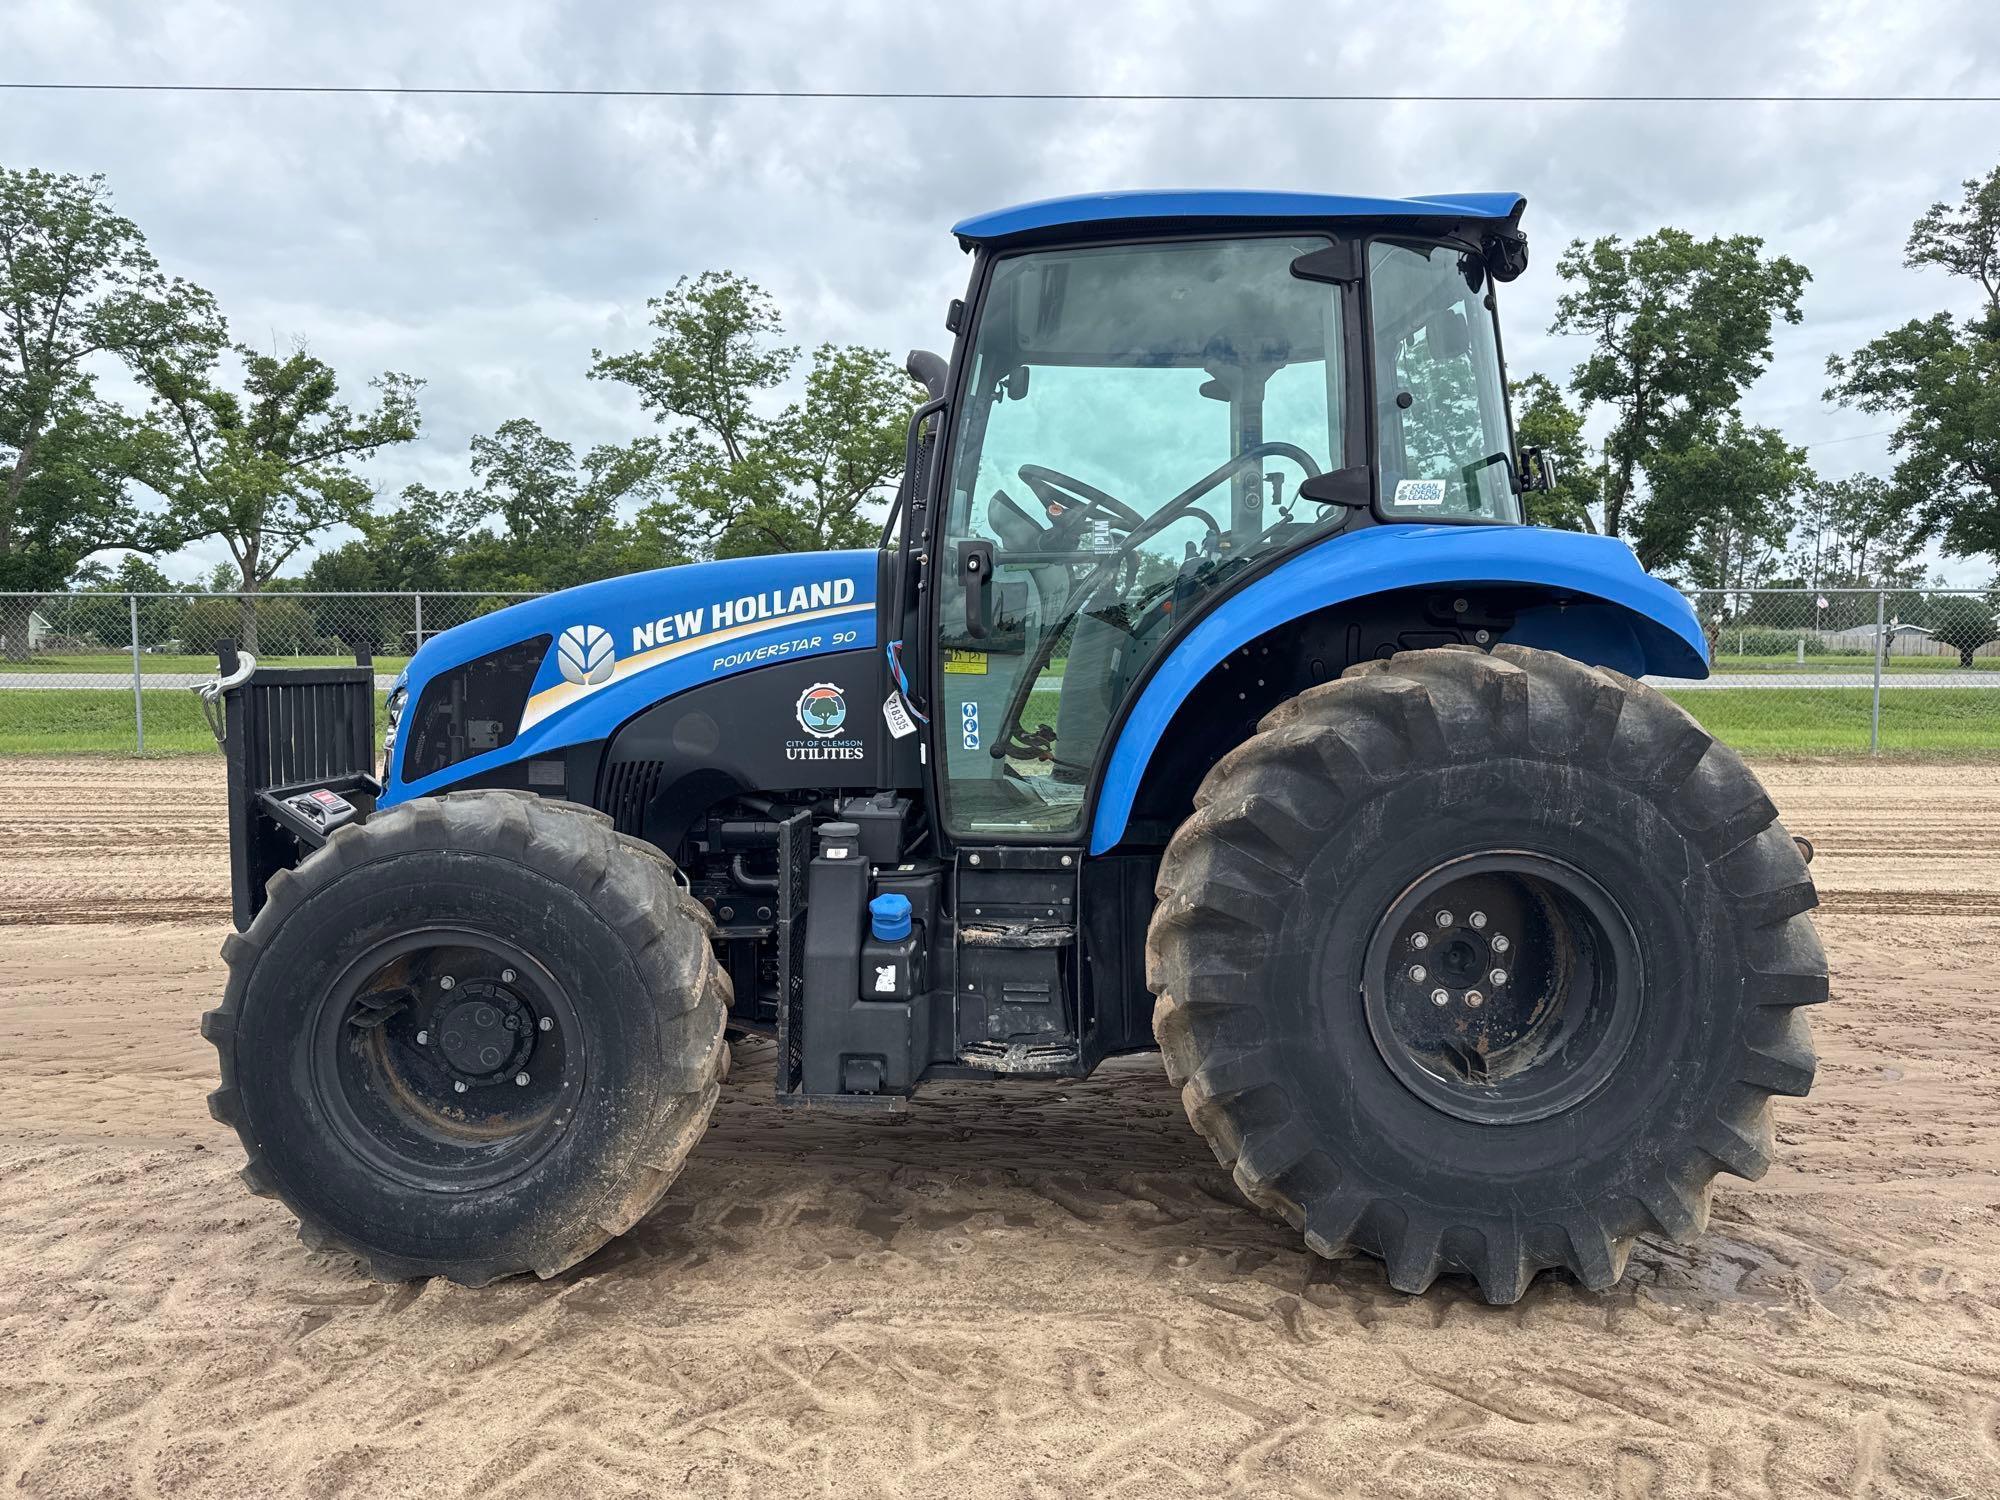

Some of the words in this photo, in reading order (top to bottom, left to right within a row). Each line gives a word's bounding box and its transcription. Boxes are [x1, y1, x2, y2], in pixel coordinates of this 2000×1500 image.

[1095, 521, 1109, 544] PLM
[633, 608, 704, 651] NEW
[712, 578, 855, 629] HOLLAND
[712, 636, 822, 671] POWERSTAR
[831, 630, 857, 645] 90
[888, 698, 909, 731] 218335
[785, 747, 864, 760] UTILITIES
[786, 740, 805, 748] CITY
[807, 740, 819, 748] OF
[821, 740, 863, 748] CLEMSON
